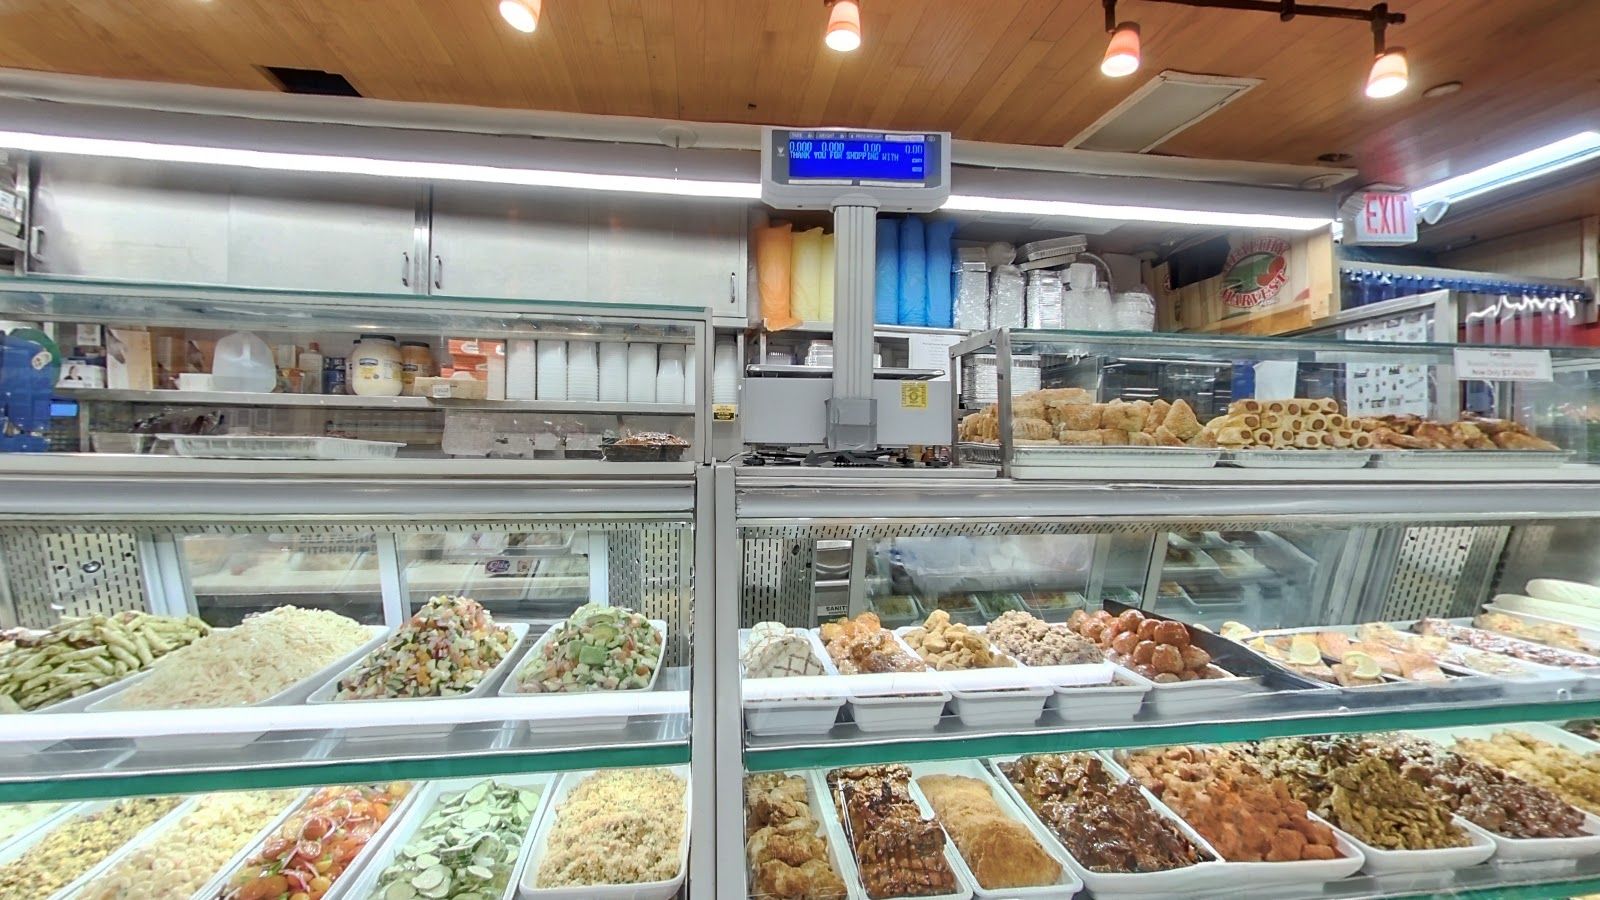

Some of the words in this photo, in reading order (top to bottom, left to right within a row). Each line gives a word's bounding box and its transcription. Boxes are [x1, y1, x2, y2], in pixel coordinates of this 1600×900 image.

[790, 141, 813, 152] 0.000
[821, 142, 845, 152] 0.000
[863, 142, 881, 153] 0.00
[905, 144, 923, 154] 0.00
[790, 151, 810, 159] THANK
[813, 151, 827, 160] YOU
[829, 151, 843, 160] FOR
[846, 151, 879, 160] SHOPPING
[882, 152, 899, 162] WITH
[1364, 191, 1408, 235] EXIT
[1221, 267, 1288, 308] HARVEST
